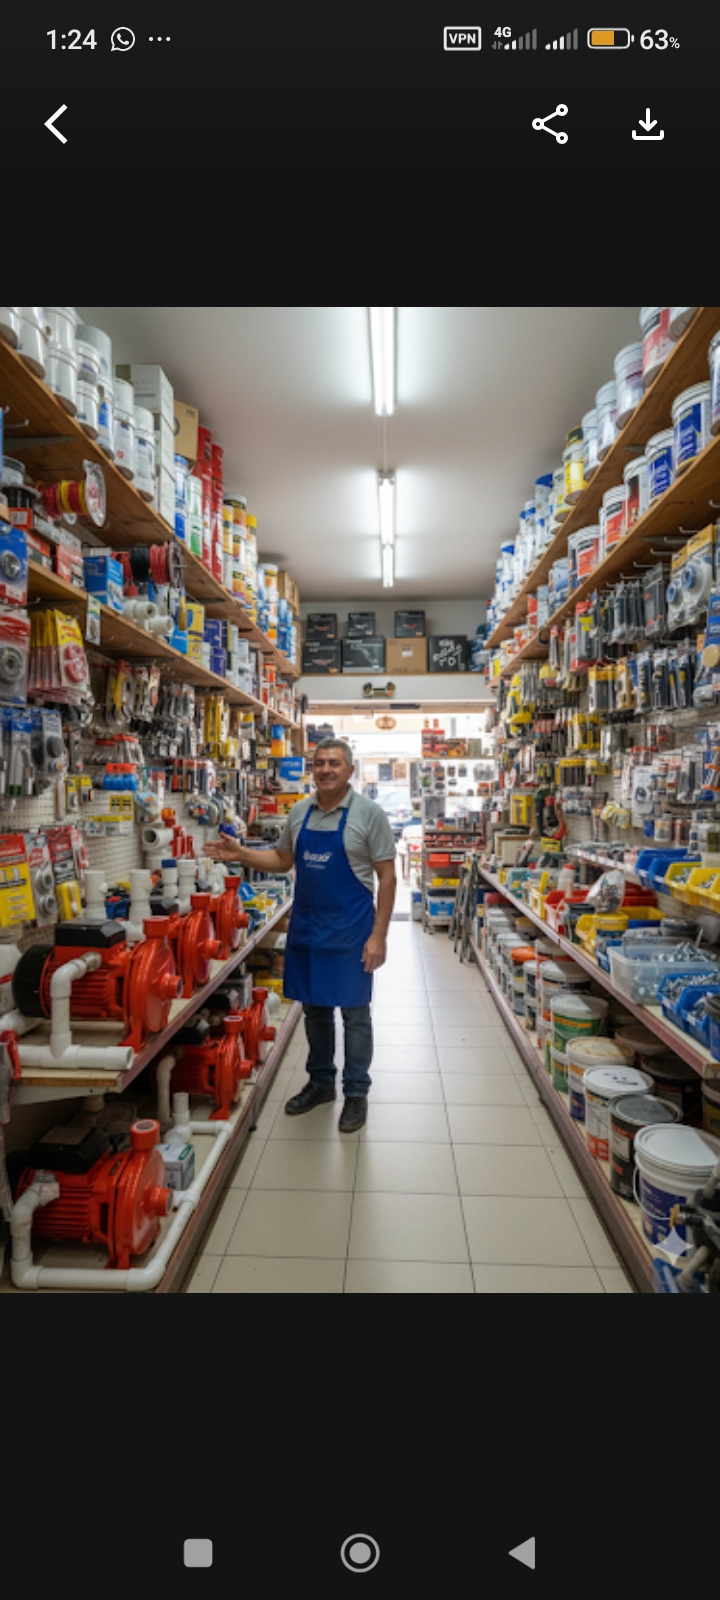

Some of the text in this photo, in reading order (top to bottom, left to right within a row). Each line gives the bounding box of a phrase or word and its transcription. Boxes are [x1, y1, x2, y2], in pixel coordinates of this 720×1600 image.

[47, 29, 97, 49] 1:24
[449, 33, 477, 45] VPN
[493, 27, 512, 38] 4G
[639, 28, 680, 49] 63%
